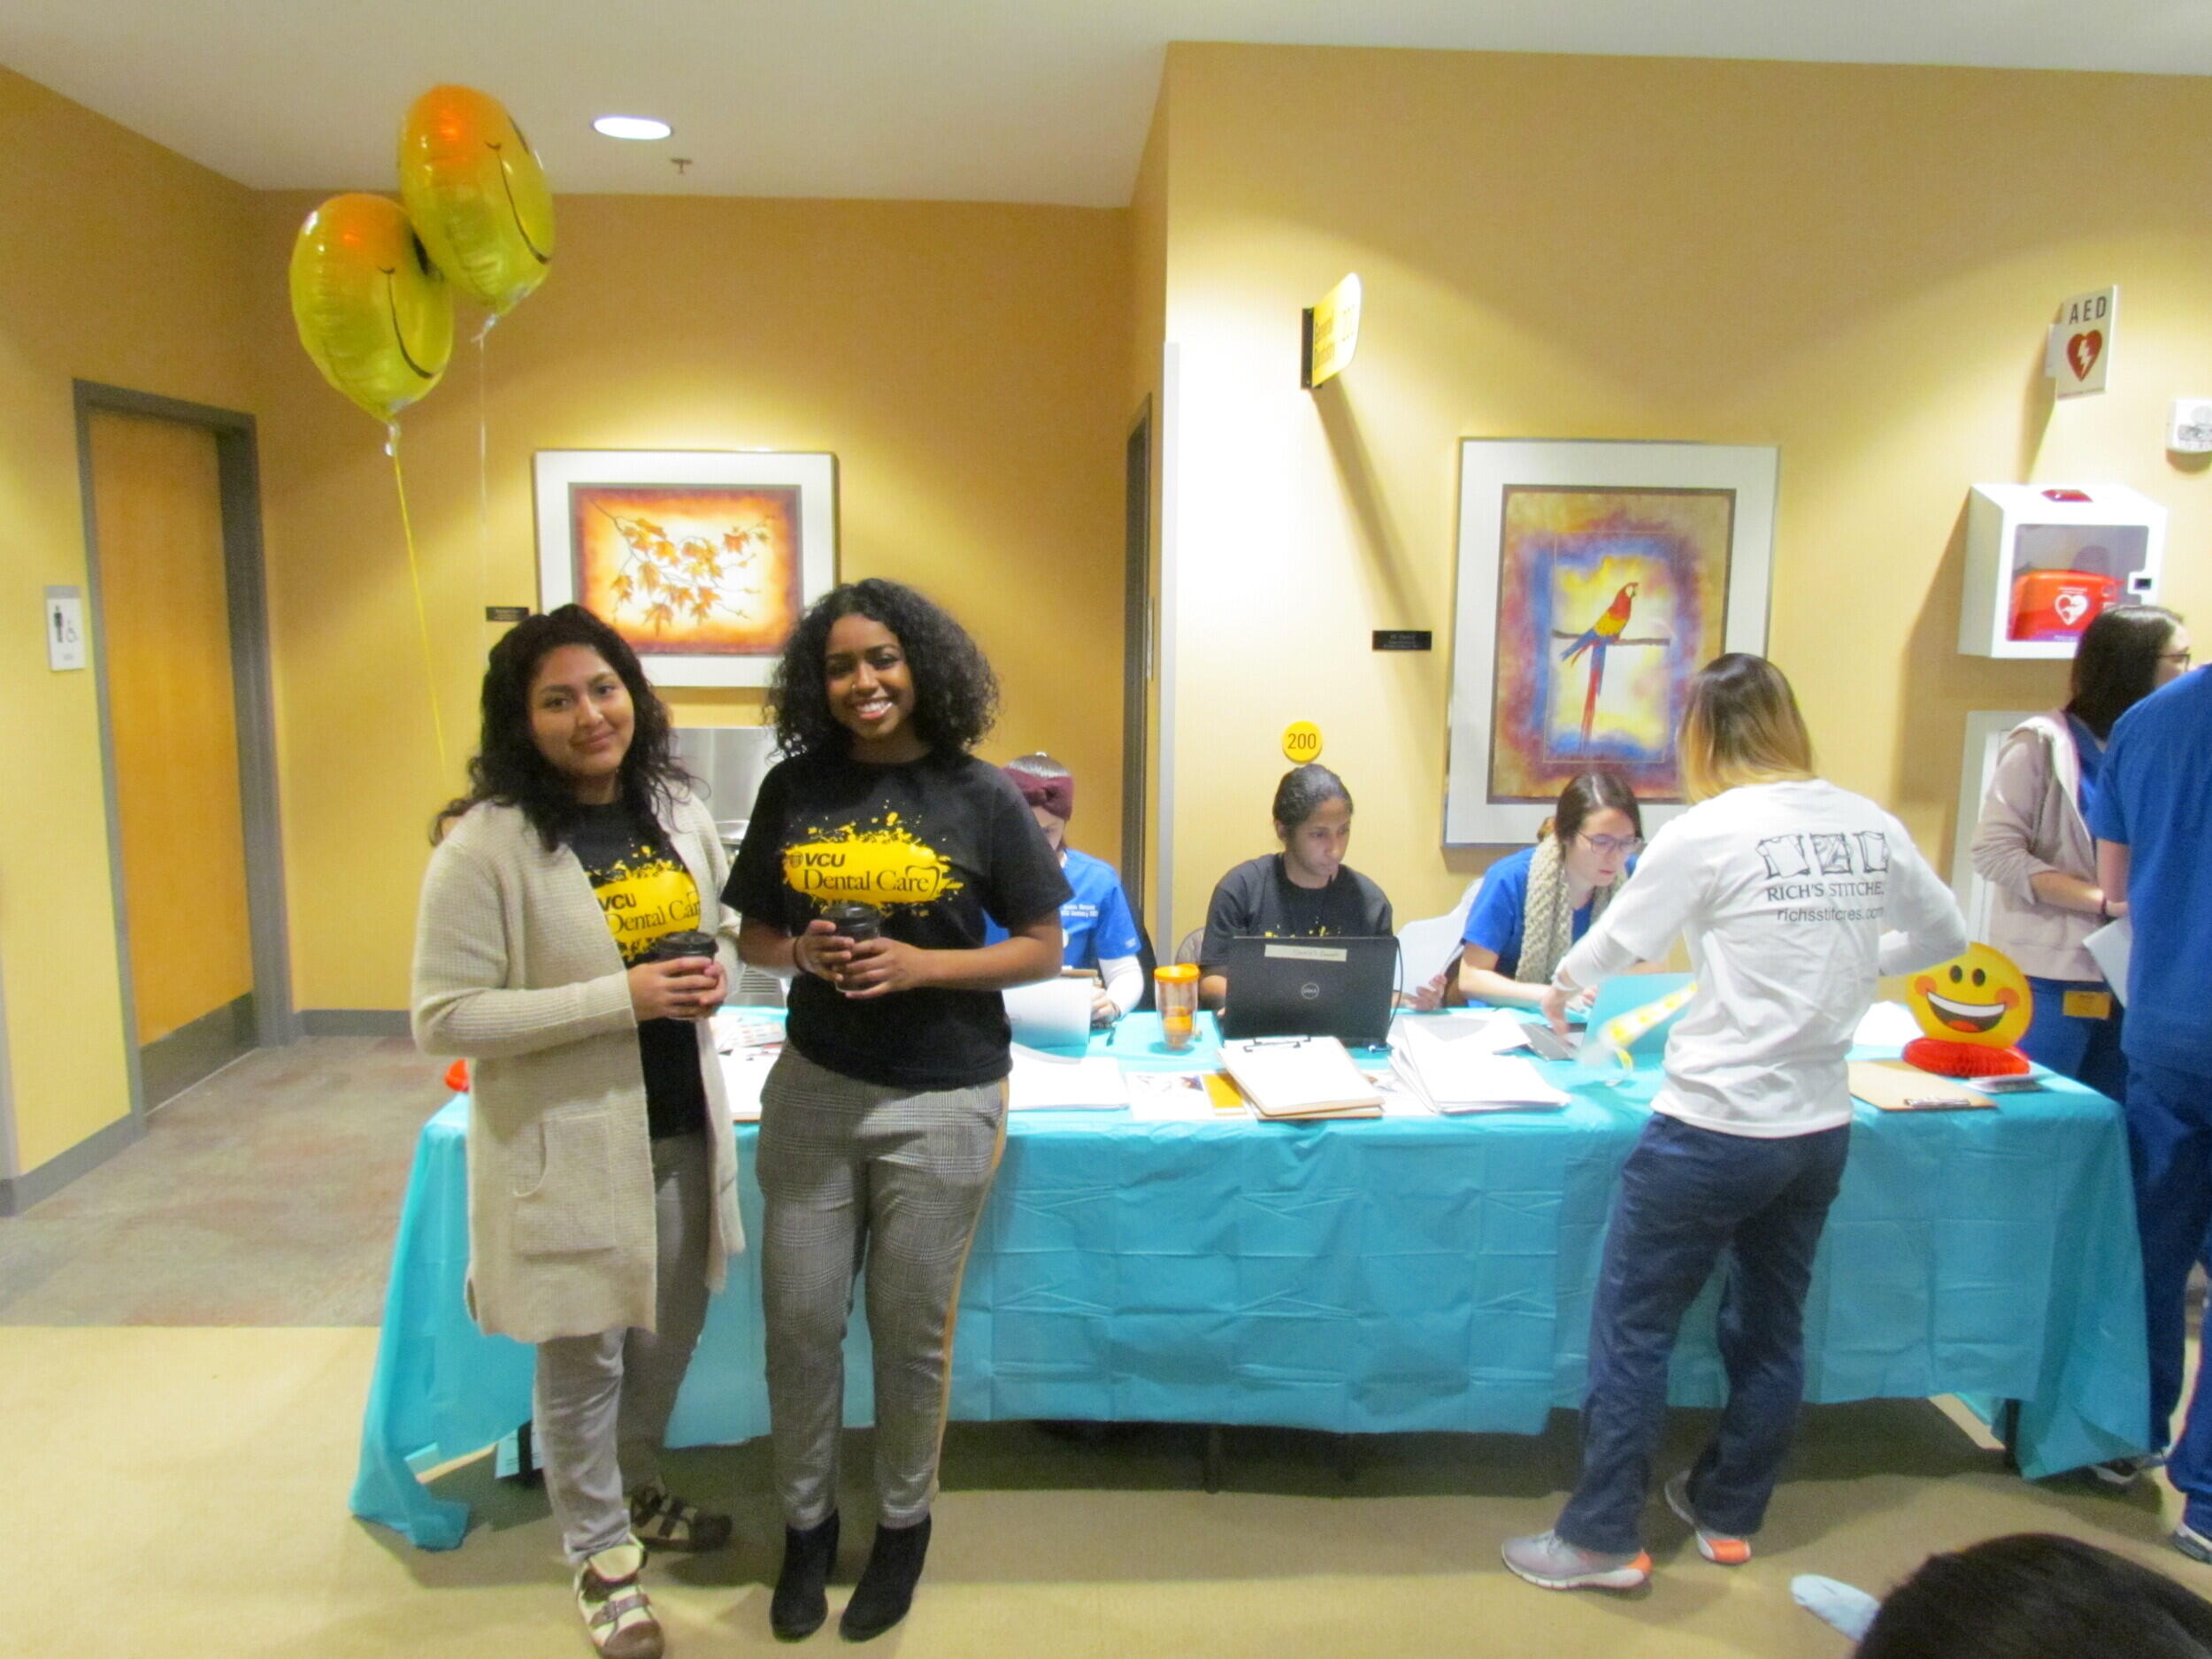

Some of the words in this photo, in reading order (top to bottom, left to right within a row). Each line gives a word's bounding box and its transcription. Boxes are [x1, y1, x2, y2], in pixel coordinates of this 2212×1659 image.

[2069, 296, 2107, 326] AED
[1287, 733, 1317, 749] 200
[804, 853, 846, 867] VCU
[804, 869, 871, 891] Dental
[876, 870, 929, 893] Care
[1766, 883, 1824, 902] RICH'S
[1829, 881, 1885, 897] STITCHE
[597, 893, 637, 912] VCU
[604, 905, 667, 935] Dental
[668, 899, 701, 922] Car
